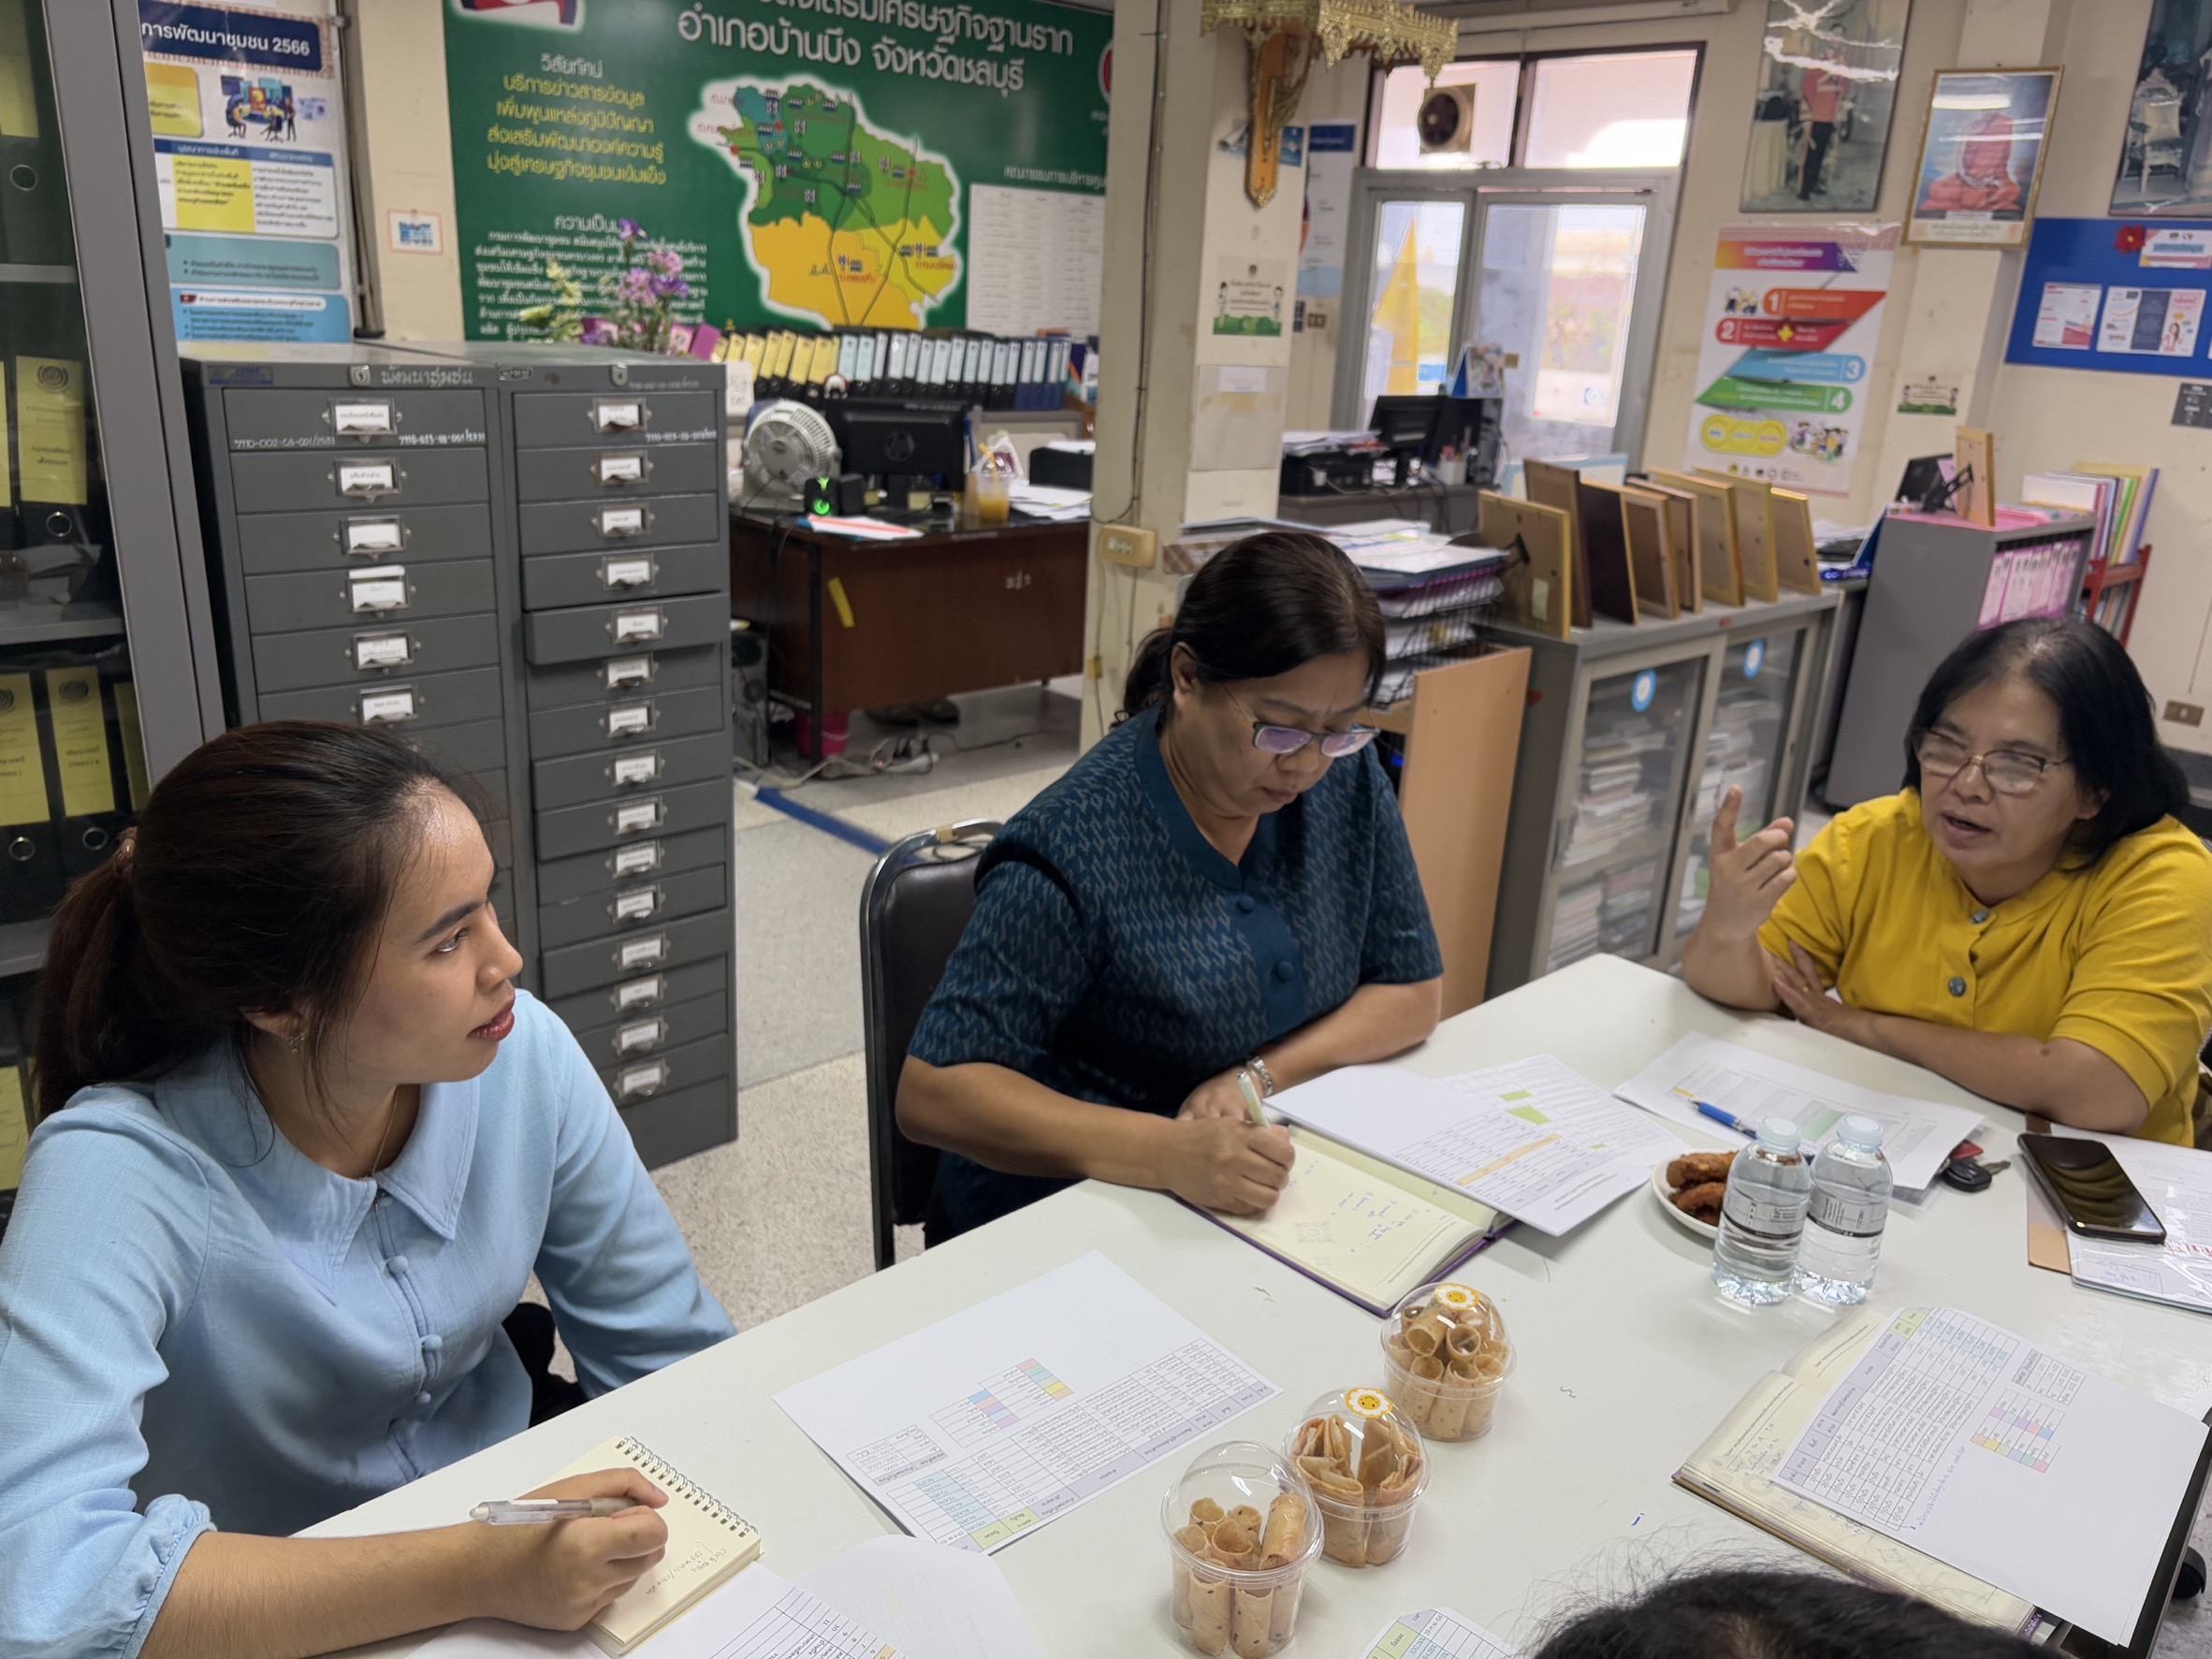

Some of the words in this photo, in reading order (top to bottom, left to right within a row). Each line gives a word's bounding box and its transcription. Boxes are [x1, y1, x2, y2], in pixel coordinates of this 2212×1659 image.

[141, 22, 269, 51] การพัฒนาชุมชน
[272, 38, 311, 56] 2566
[677, 3, 861, 66] อำเภอบ้านบึง
[871, 35, 1026, 98] จังหวัดชลบุรี
[541, 52, 604, 79] วิสัยทัศน์
[502, 73, 646, 109] บริการข่าวสารข้อมูล
[496, 95, 655, 134] เพิ่มพูนแหล่งภูมิปัญญา
[487, 123, 665, 164] ส่งเสริมพัฒนาองค์ความรู้
[554, 214, 619, 235] ความเป็น
[1768, 294, 1779, 313] 1
[1720, 322, 1736, 340] 2
[1845, 360, 1860, 380] 3
[1830, 389, 1846, 409] 4
